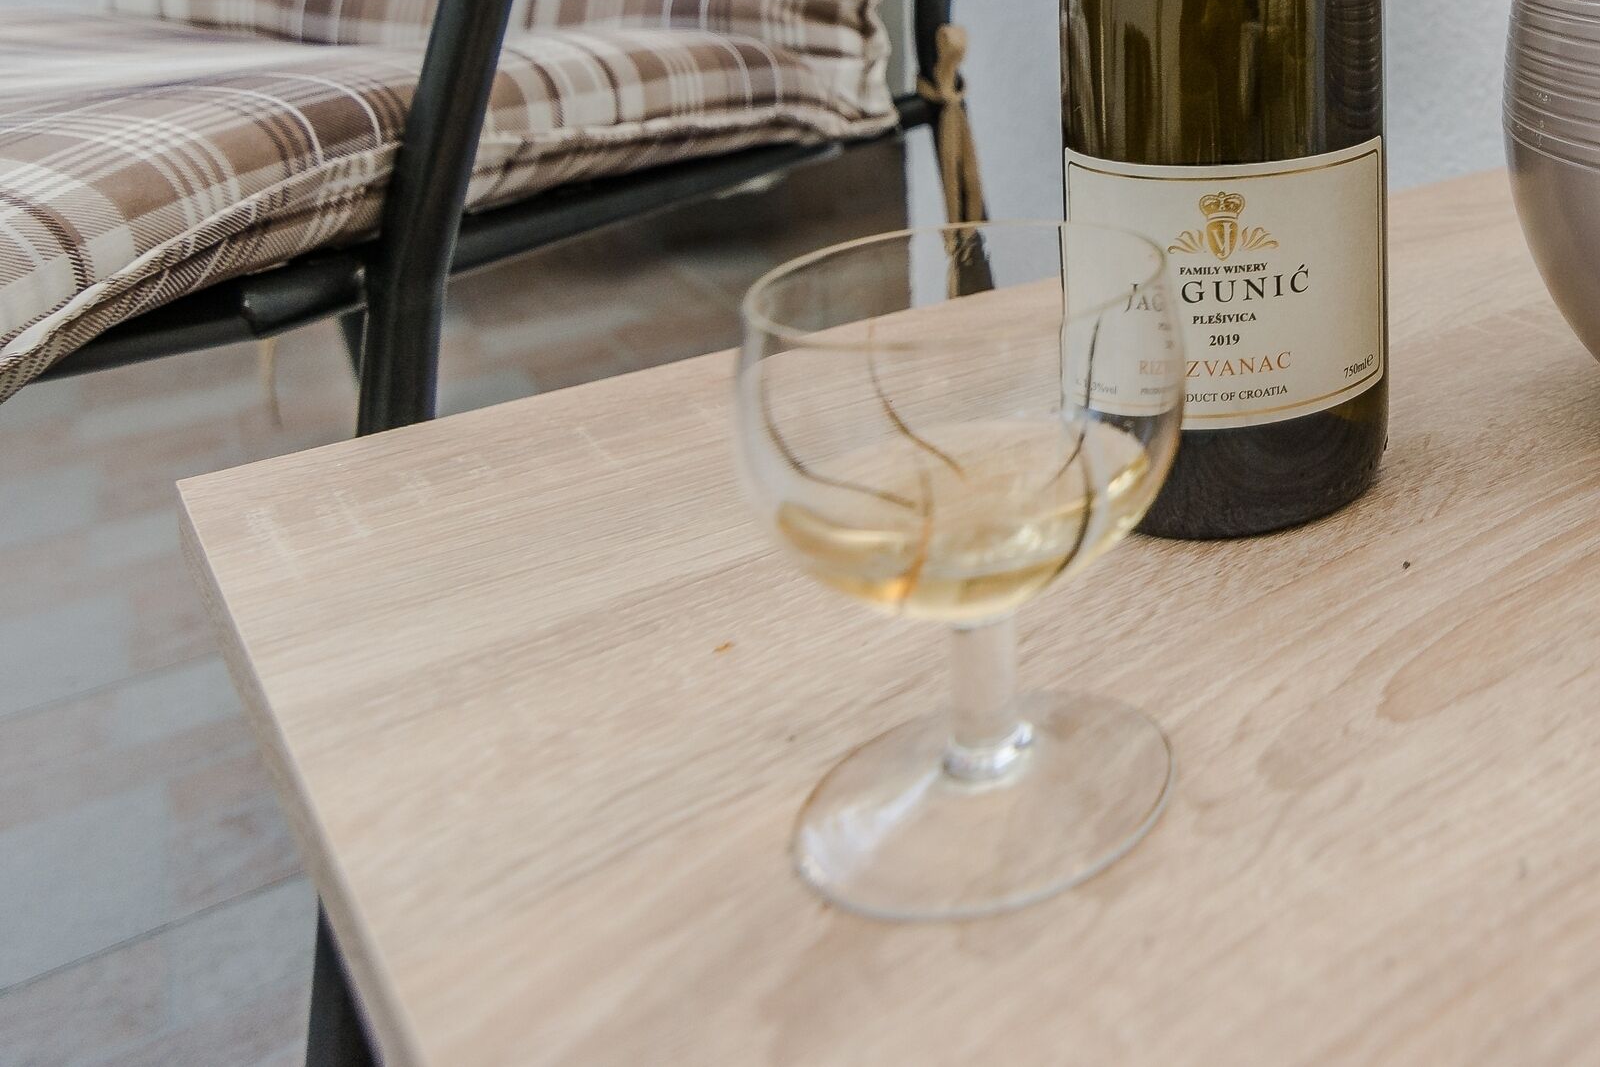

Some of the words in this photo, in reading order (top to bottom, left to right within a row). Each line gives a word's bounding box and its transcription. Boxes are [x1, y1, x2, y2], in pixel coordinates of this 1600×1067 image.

[1179, 266, 1220, 275] FAMILY
[1223, 262, 1268, 274] WINERY
[1192, 312, 1257, 325] PLEŠIVICA
[1209, 334, 1240, 347] 2019
[1220, 392, 1236, 401] OF
[1238, 385, 1288, 400] CROATIA
